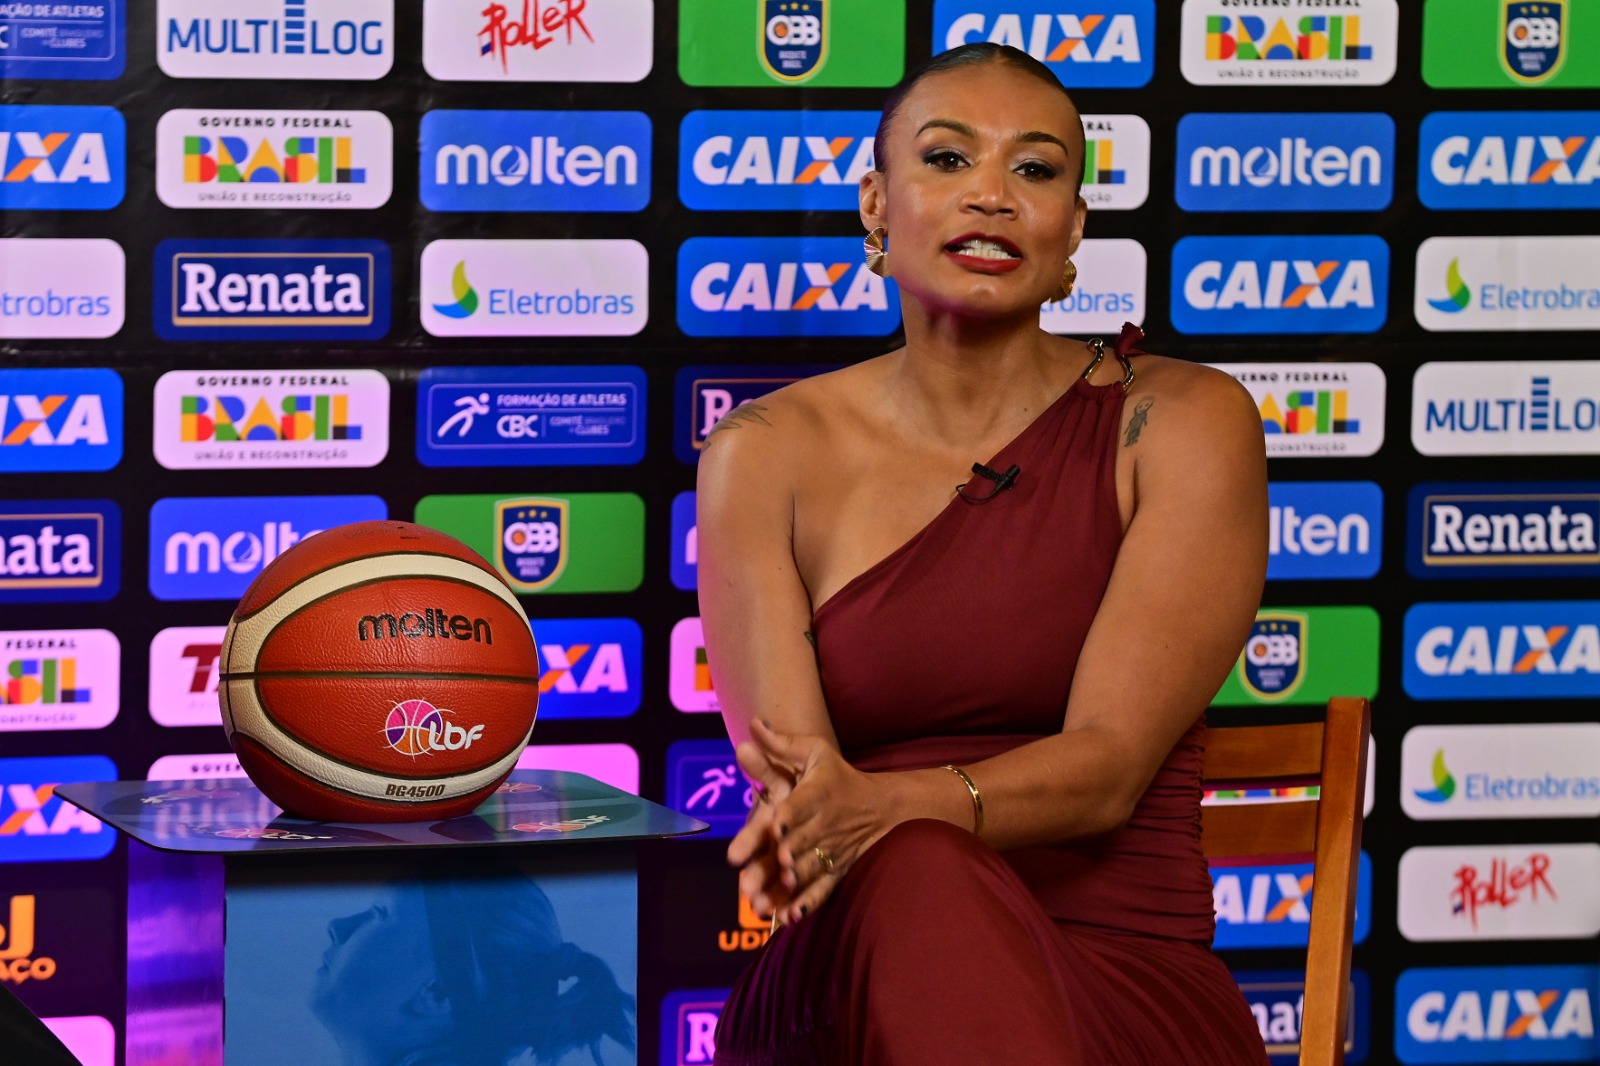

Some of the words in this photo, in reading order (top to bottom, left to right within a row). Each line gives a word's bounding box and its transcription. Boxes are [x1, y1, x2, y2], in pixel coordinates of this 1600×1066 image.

[33, 4, 51, 17] DE
[52, 5, 105, 18] ATLETAS
[945, 13, 1141, 62] CAIXA
[1205, 15, 1373, 60] BRASIL
[199, 117, 275, 128] GOVERNO
[283, 117, 353, 128] FEDERAL
[183, 136, 366, 183] BRASIL
[436, 137, 637, 186] molten
[1190, 138, 1381, 187] molten
[2, 290, 111, 317] trobras
[181, 263, 365, 314] Renata
[489, 288, 634, 315] Eletrobras
[690, 262, 888, 311] CAIXA
[1184, 260, 1375, 309] CAIXA
[1481, 283, 1600, 310] Eletrobra
[196, 376, 272, 387] GOVERNO
[279, 376, 349, 386] FEDERAL
[1286, 372, 1349, 382] FEDERAL
[181, 394, 362, 442] BRASIL
[497, 392, 561, 408] FORMAÇÃO
[561, 393, 577, 406] DE
[578, 393, 627, 406] ATLETAS
[1259, 390, 1360, 434] ASIL
[1426, 399, 1600, 431] MULTILO
[496, 414, 538, 438] CBC
[1269, 506, 1369, 554] lten
[1431, 505, 1596, 552] Renata
[358, 608, 493, 645] molten
[1415, 625, 1600, 676] CAIXA
[385, 783, 446, 797] BG4500
[1465, 772, 1600, 801] Eletrobras
[1213, 873, 1314, 923] AIX
[1408, 989, 1594, 1041] CAIXA
